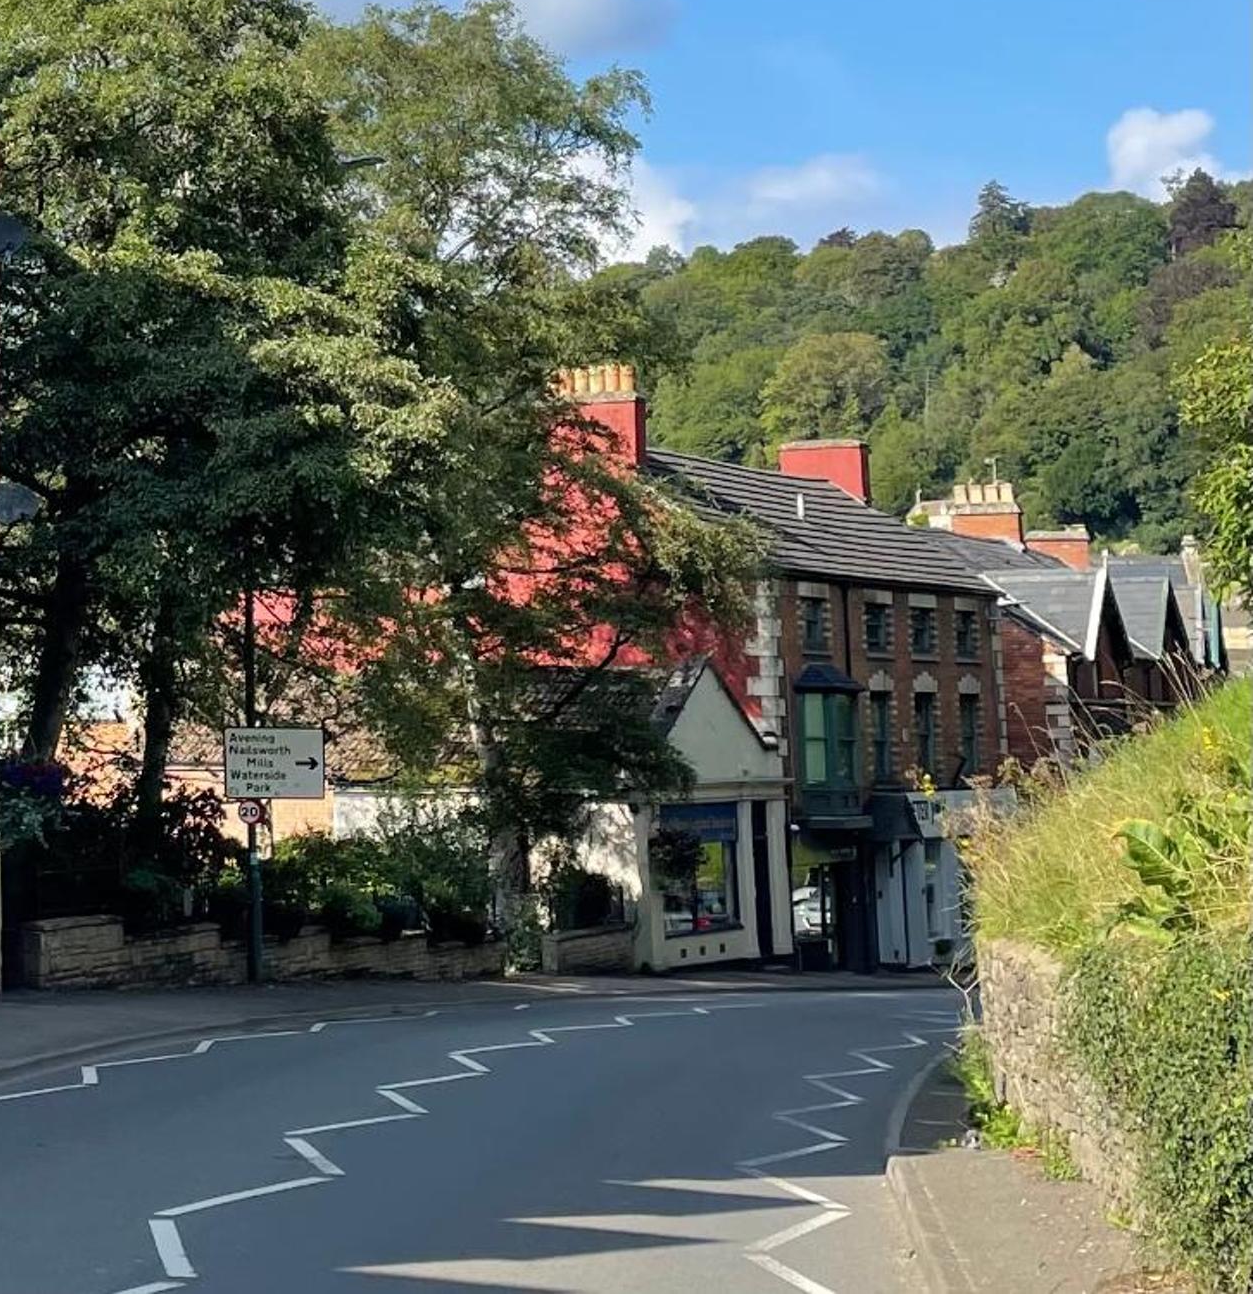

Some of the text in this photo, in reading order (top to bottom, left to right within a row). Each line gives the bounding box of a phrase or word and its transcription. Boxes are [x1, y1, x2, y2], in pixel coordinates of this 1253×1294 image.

[229, 732, 276, 745] Avening
[229, 745, 291, 756] Nailsworth
[247, 758, 274, 768] Mills
[230, 769, 287, 781] Waterside
[246, 782, 271, 793] Park
[241, 807, 259, 817] 20
